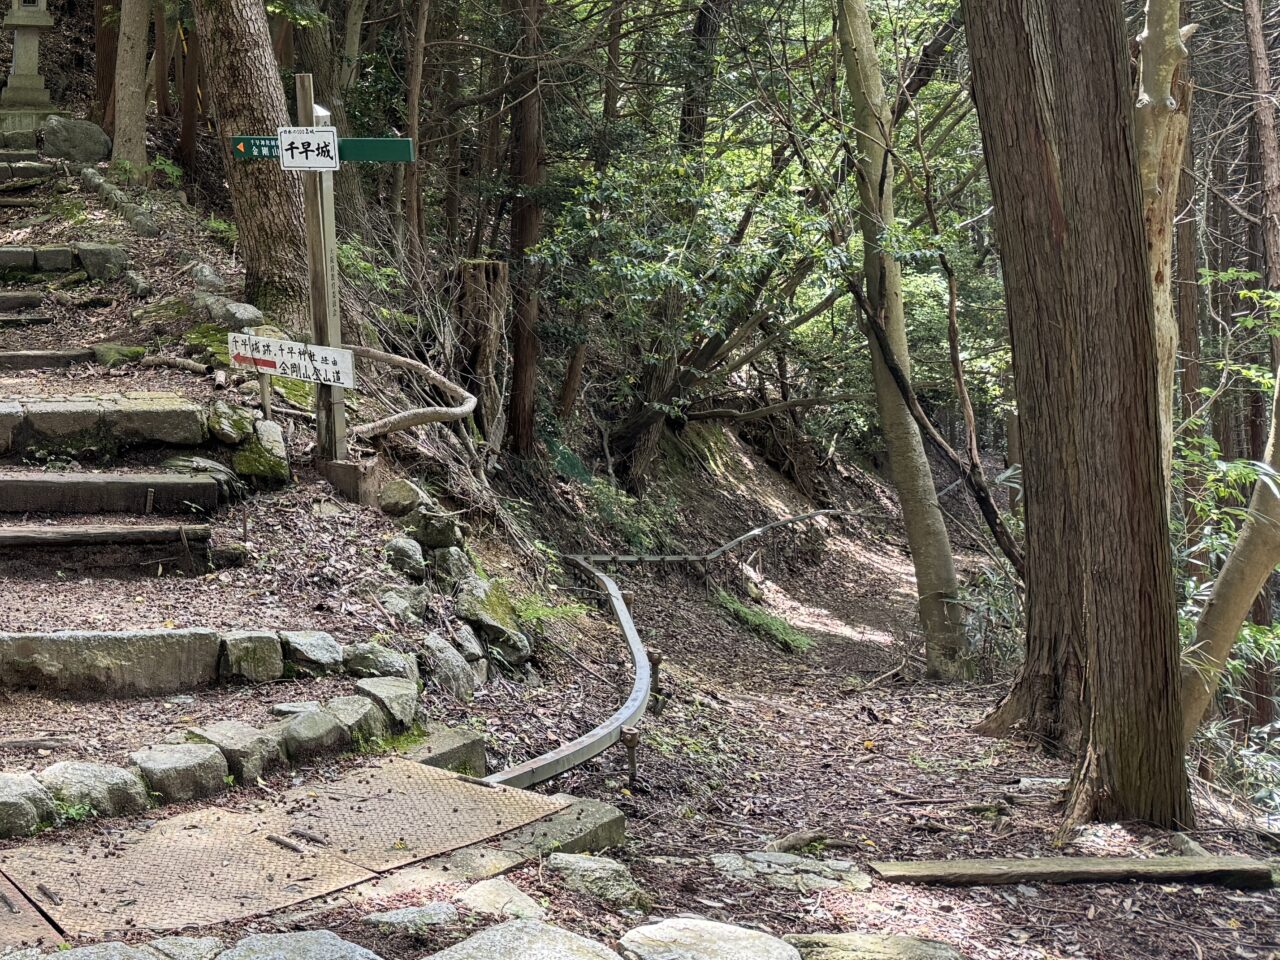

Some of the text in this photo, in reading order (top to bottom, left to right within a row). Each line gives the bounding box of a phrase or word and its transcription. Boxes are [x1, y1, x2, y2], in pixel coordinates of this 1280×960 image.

[284, 141, 333, 160] 千早城
[279, 361, 344, 385] 金剛山登山道
